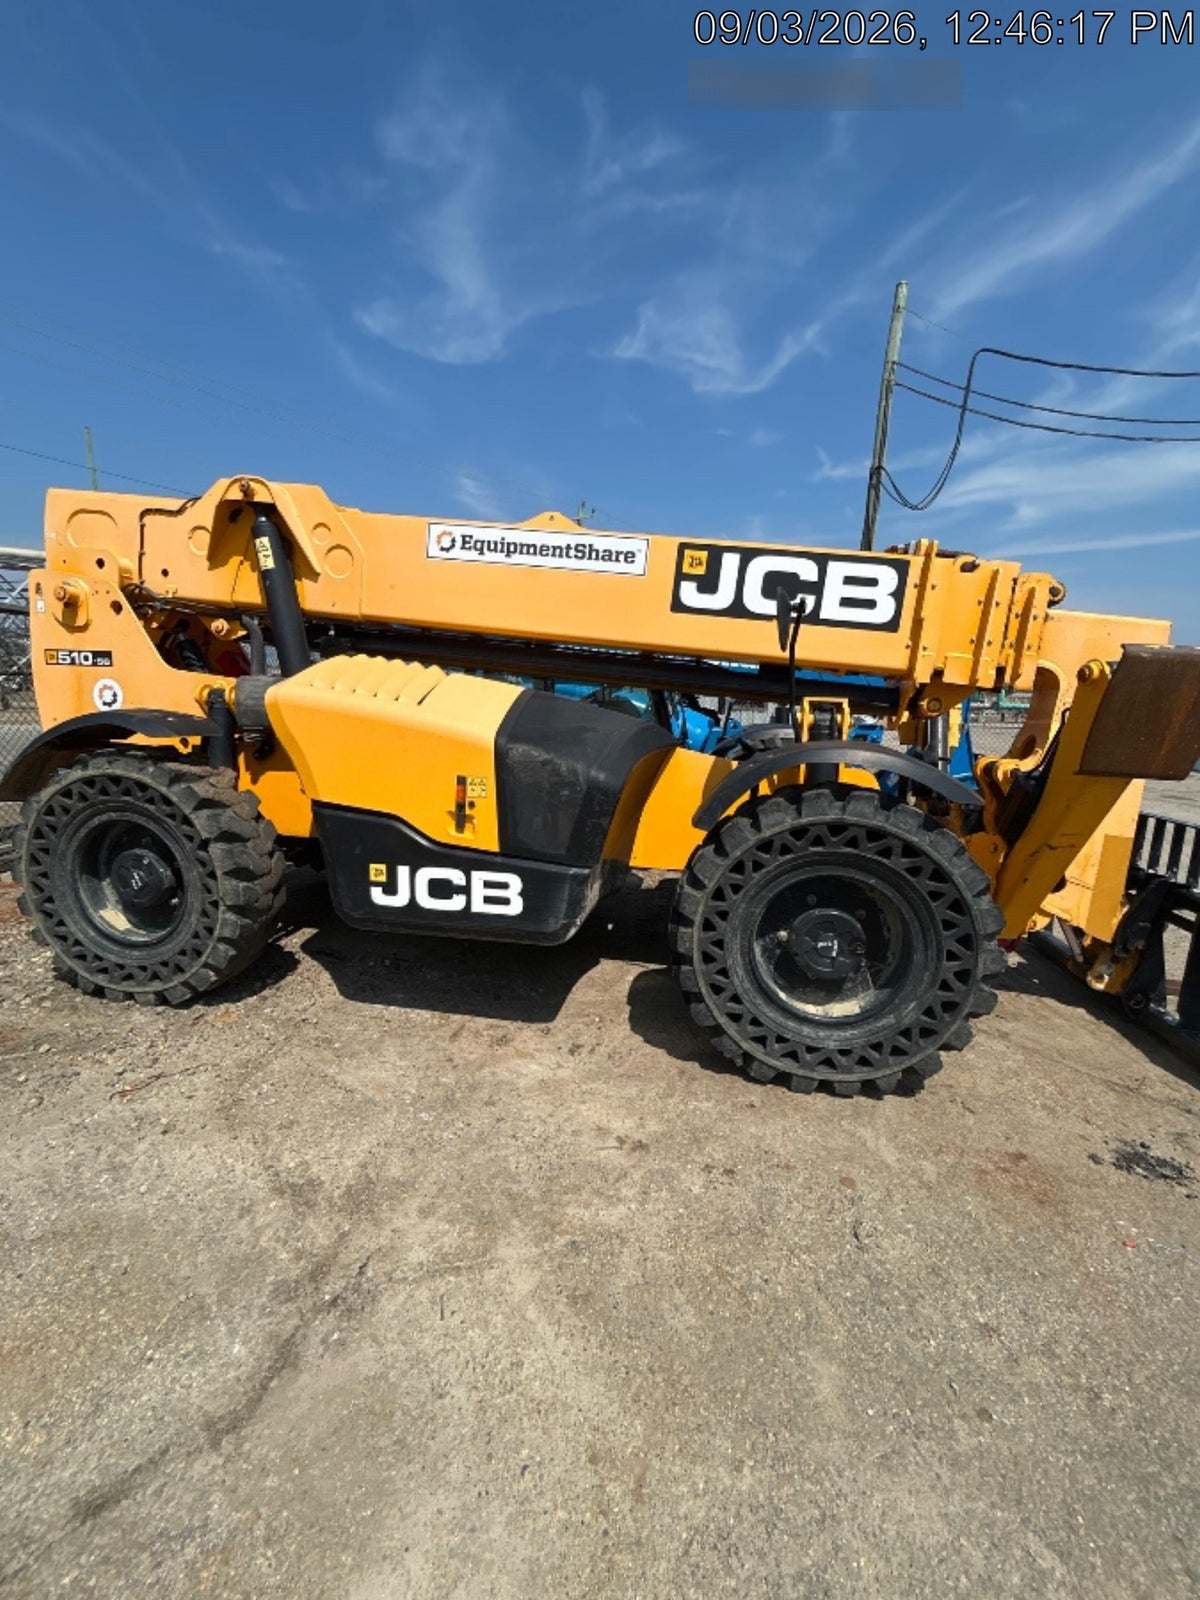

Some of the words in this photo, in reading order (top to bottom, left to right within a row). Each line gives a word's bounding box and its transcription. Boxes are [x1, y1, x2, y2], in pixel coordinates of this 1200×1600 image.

[460, 534, 636, 564] EquipmentShare
[679, 552, 899, 624] JCB
[369, 865, 524, 916] JCB
